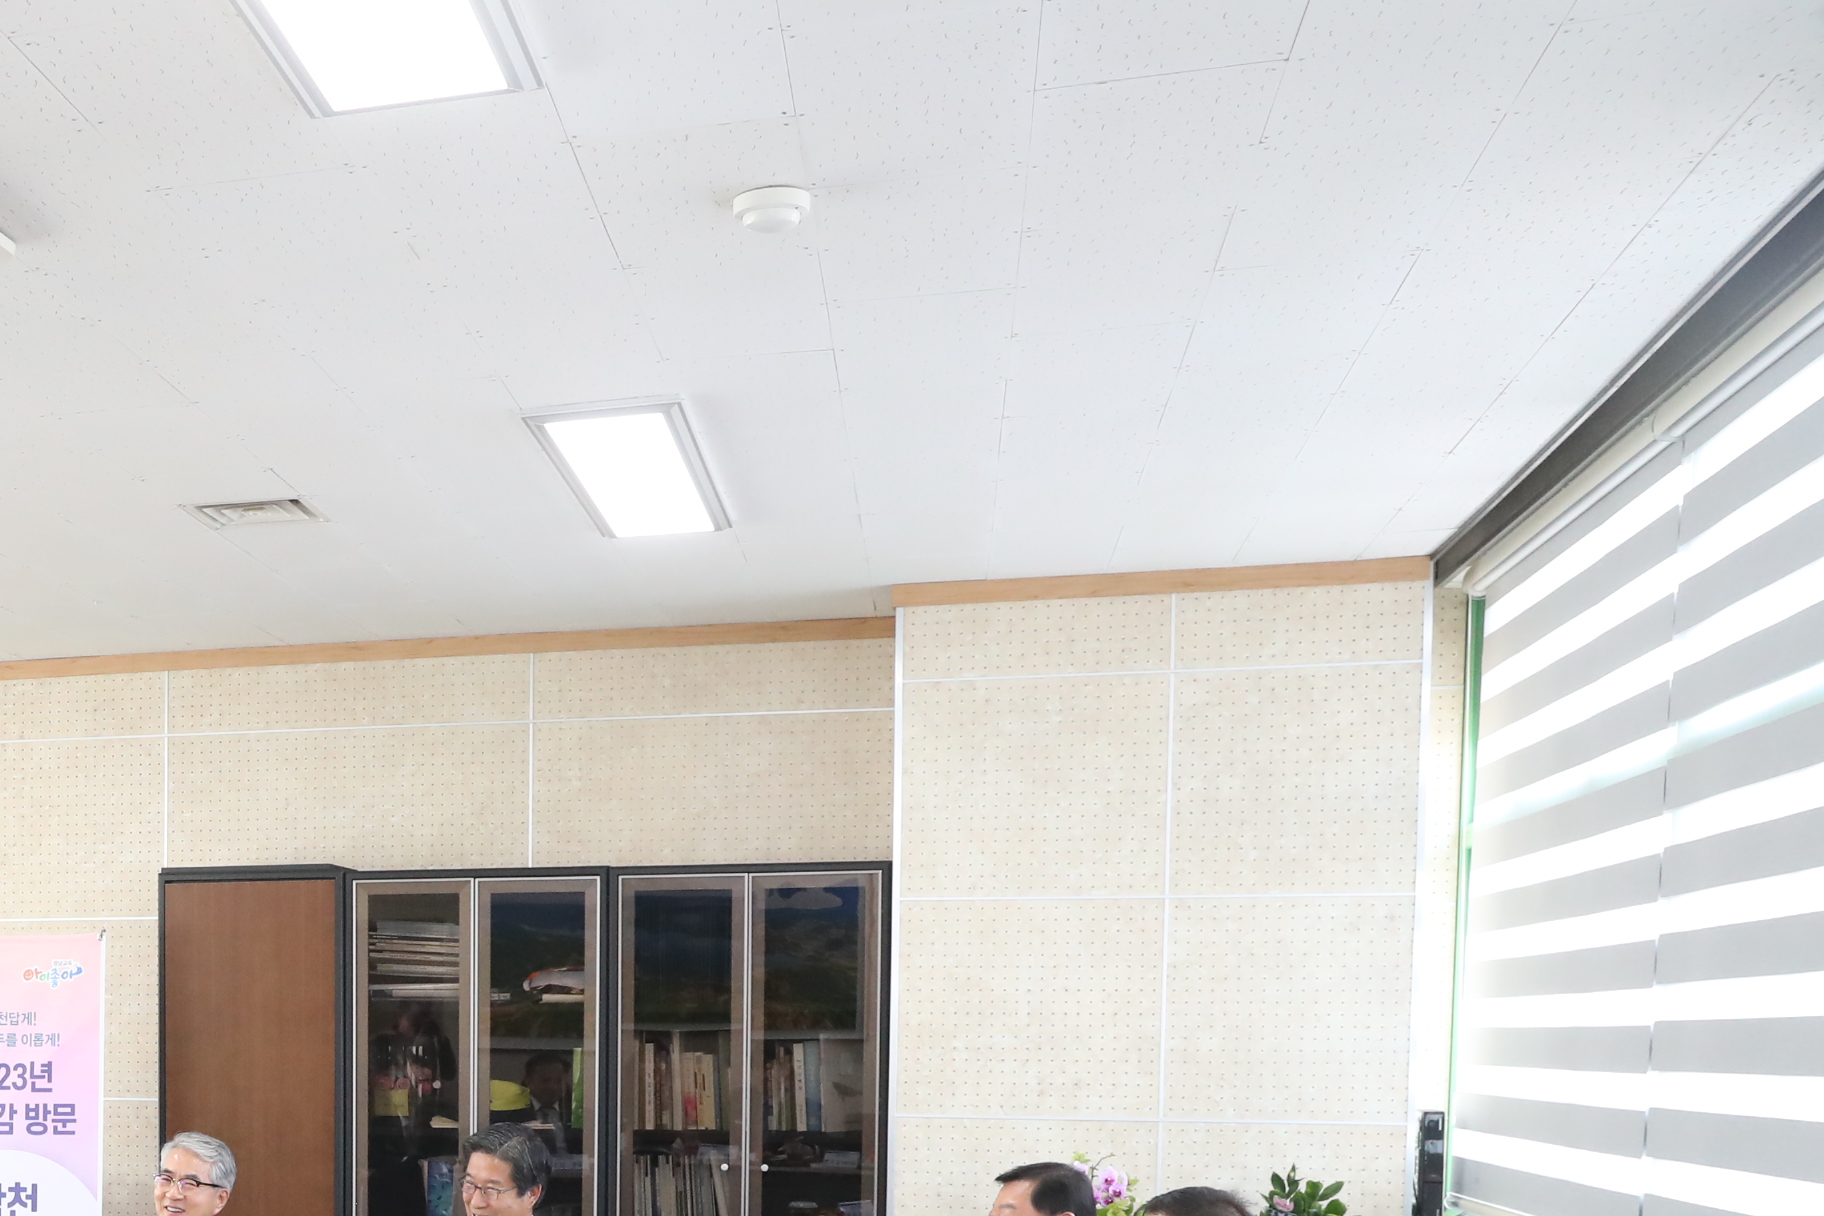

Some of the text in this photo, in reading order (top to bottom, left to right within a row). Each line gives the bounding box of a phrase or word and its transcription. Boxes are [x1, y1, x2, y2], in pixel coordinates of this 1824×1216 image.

[23, 966, 83, 988] 아이좋아
[21, 1032, 60, 1048] 이롭게!
[25, 1102, 77, 1136] 방문
